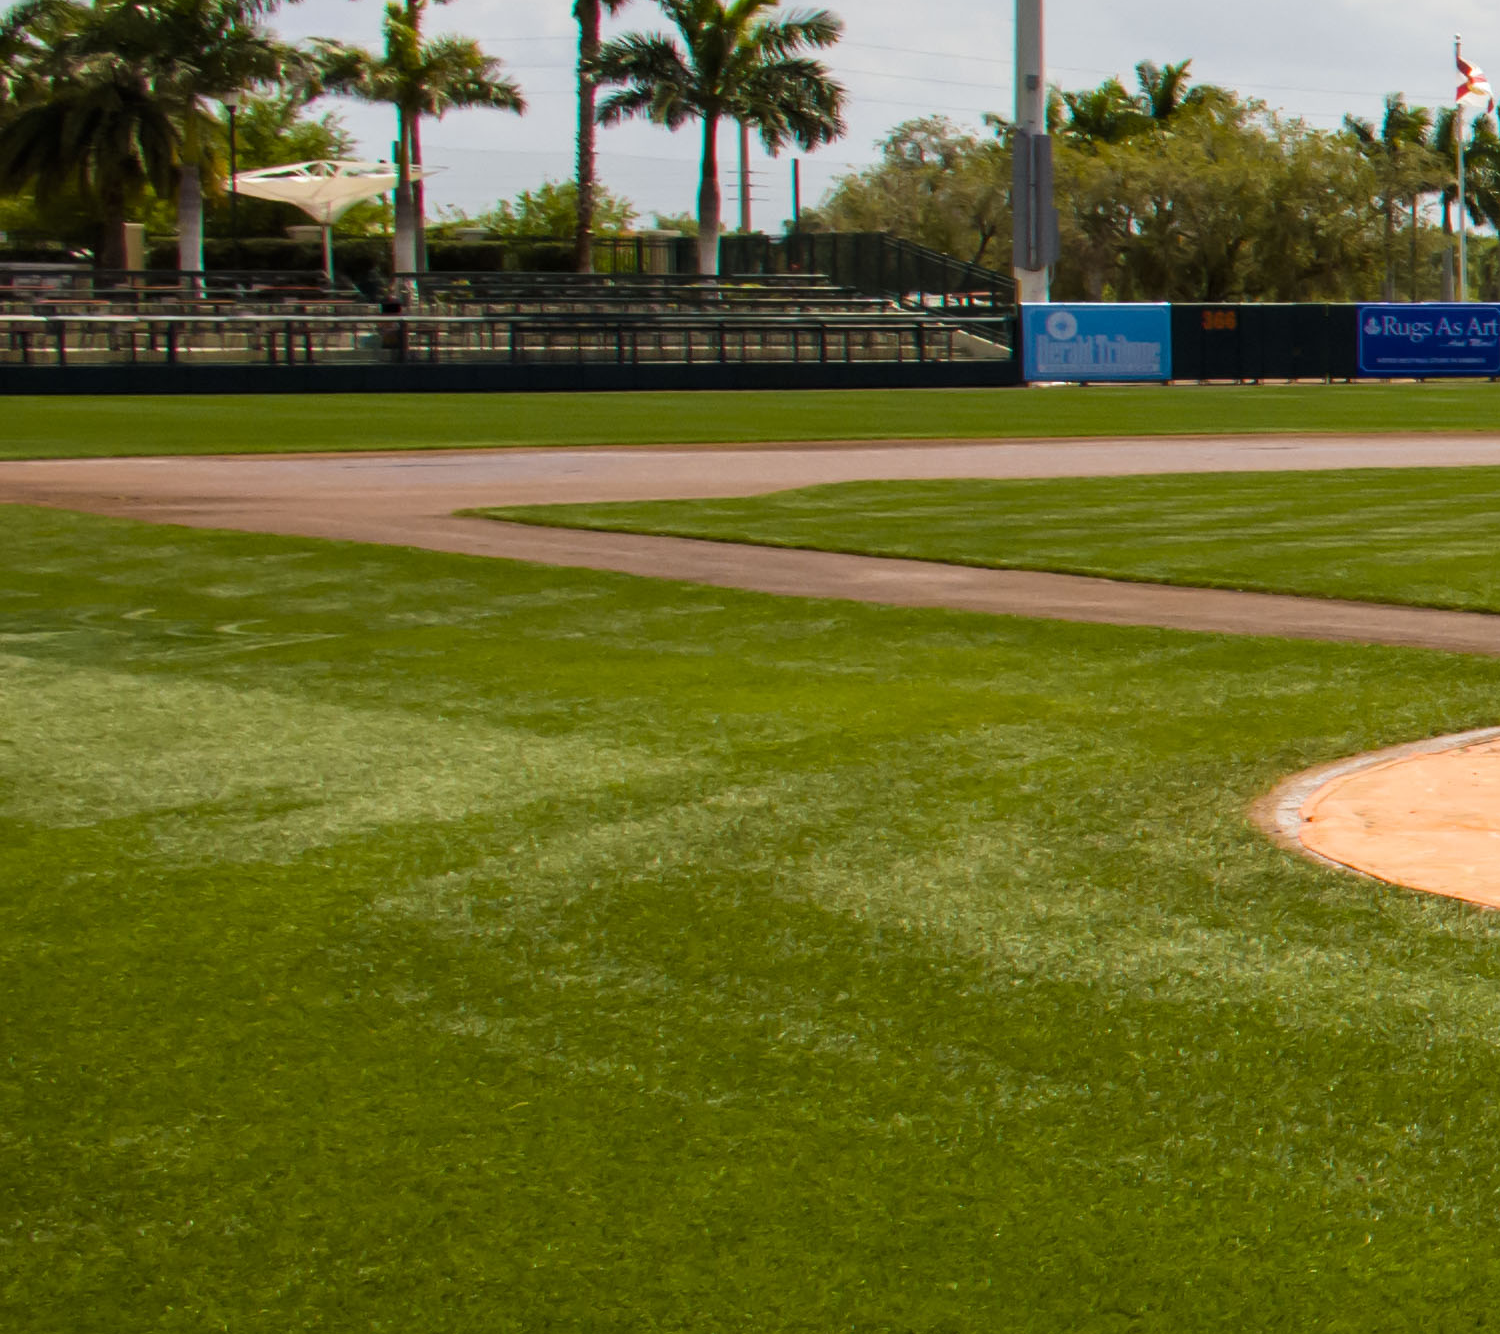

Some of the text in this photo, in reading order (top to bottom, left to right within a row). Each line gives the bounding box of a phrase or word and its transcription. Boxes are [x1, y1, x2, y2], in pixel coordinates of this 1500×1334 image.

[1382, 316, 1499, 342] Rugs As Art
